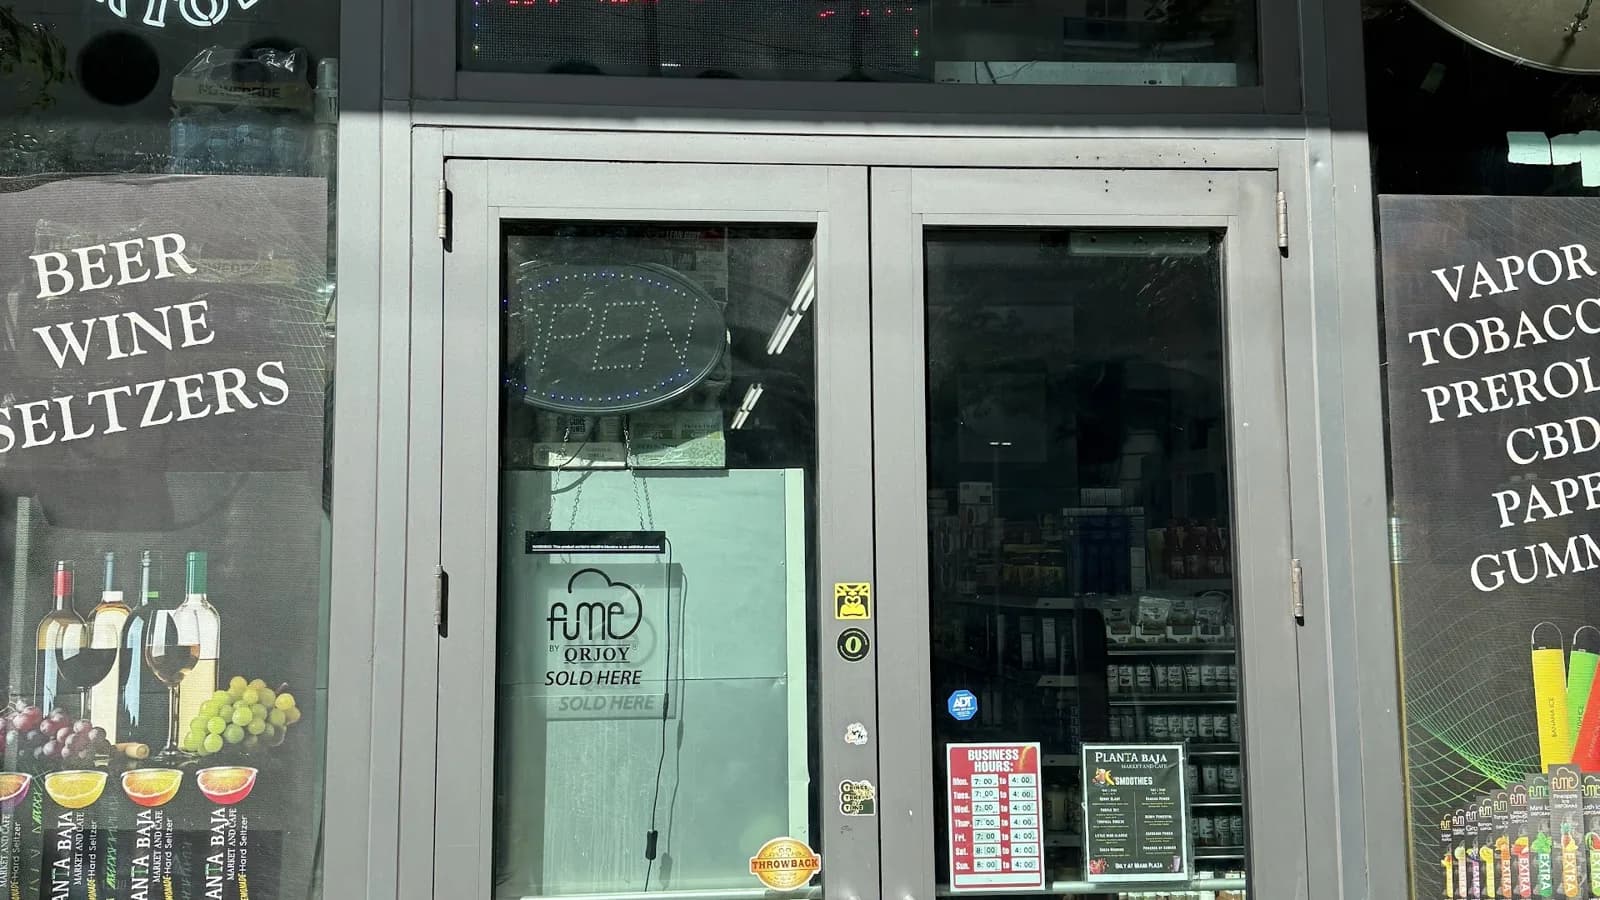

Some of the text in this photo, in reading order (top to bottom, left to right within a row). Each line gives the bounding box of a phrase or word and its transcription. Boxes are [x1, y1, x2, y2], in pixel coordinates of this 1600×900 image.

[29, 232, 197, 299] BEER
[1431, 243, 1597, 303] VAPOR
[33, 300, 215, 370] WINE
[1506, 415, 1600, 465] CBD
[563, 647, 631, 664] QRJOY
[545, 670, 642, 686] SOLD HERE
[953, 696, 973, 708] ADT
[967, 748, 1019, 761] BUSINESS
[974, 760, 1014, 772] HOURS:
[1095, 751, 1168, 764] PLANTA BAJA
[1115, 776, 1153, 785] SMOOTHIES
[57, 811, 77, 851] BAJA
[75, 833, 84, 851] AND
[88, 820, 98, 851] Seltzer
[136, 809, 155, 848] BAJA
[154, 831, 163, 849] AND
[164, 817, 173, 849] Seltzer
[210, 807, 229, 846] BAJA
[228, 829, 237, 847] AND
[239, 815, 248, 847] Seltzer
[73, 853, 84, 886] MARKET
[152, 850, 162, 883] MARKET
[226, 848, 236, 881] MARKET
[752, 858, 819, 870] THROWBACK
[1002, 861, 1010, 869] to
[1519, 858, 1530, 893] EXTRA
[1540, 853, 1551, 891] EXTRA
[1564, 852, 1577, 893] EXTRA
